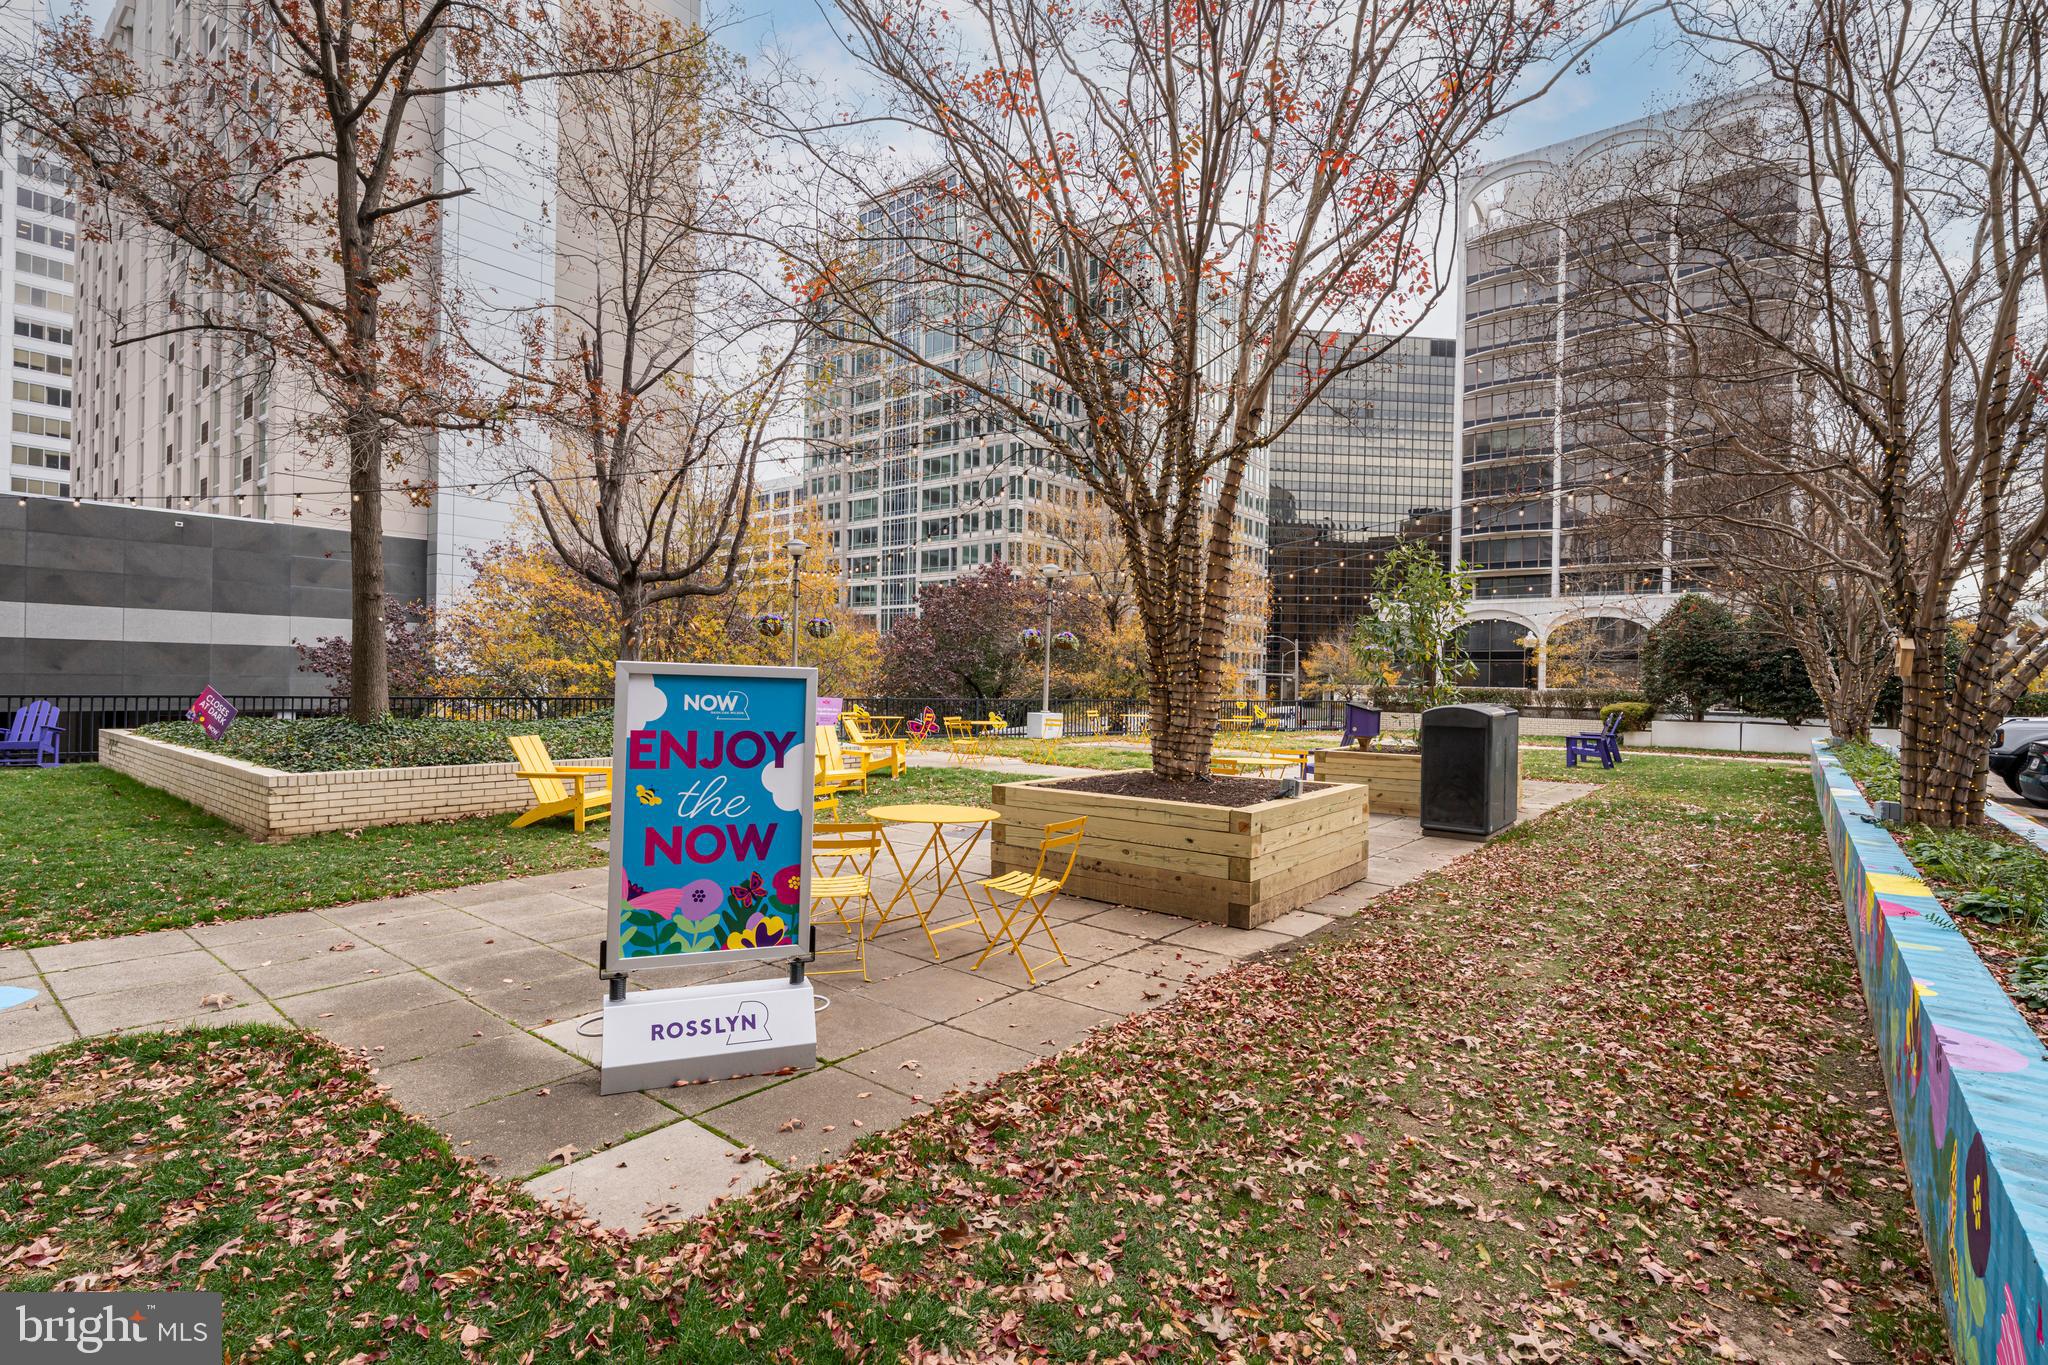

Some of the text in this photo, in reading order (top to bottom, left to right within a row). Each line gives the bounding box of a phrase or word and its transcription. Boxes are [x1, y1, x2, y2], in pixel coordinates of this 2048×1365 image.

[199, 700, 227, 725] AT DARK
[206, 694, 230, 717] CLOSES
[684, 694, 738, 711] NOW
[629, 730, 797, 769] ENJOY
[677, 775, 751, 819] the
[644, 823, 778, 866] NOW
[651, 1014, 756, 1041] ROSSLYN
